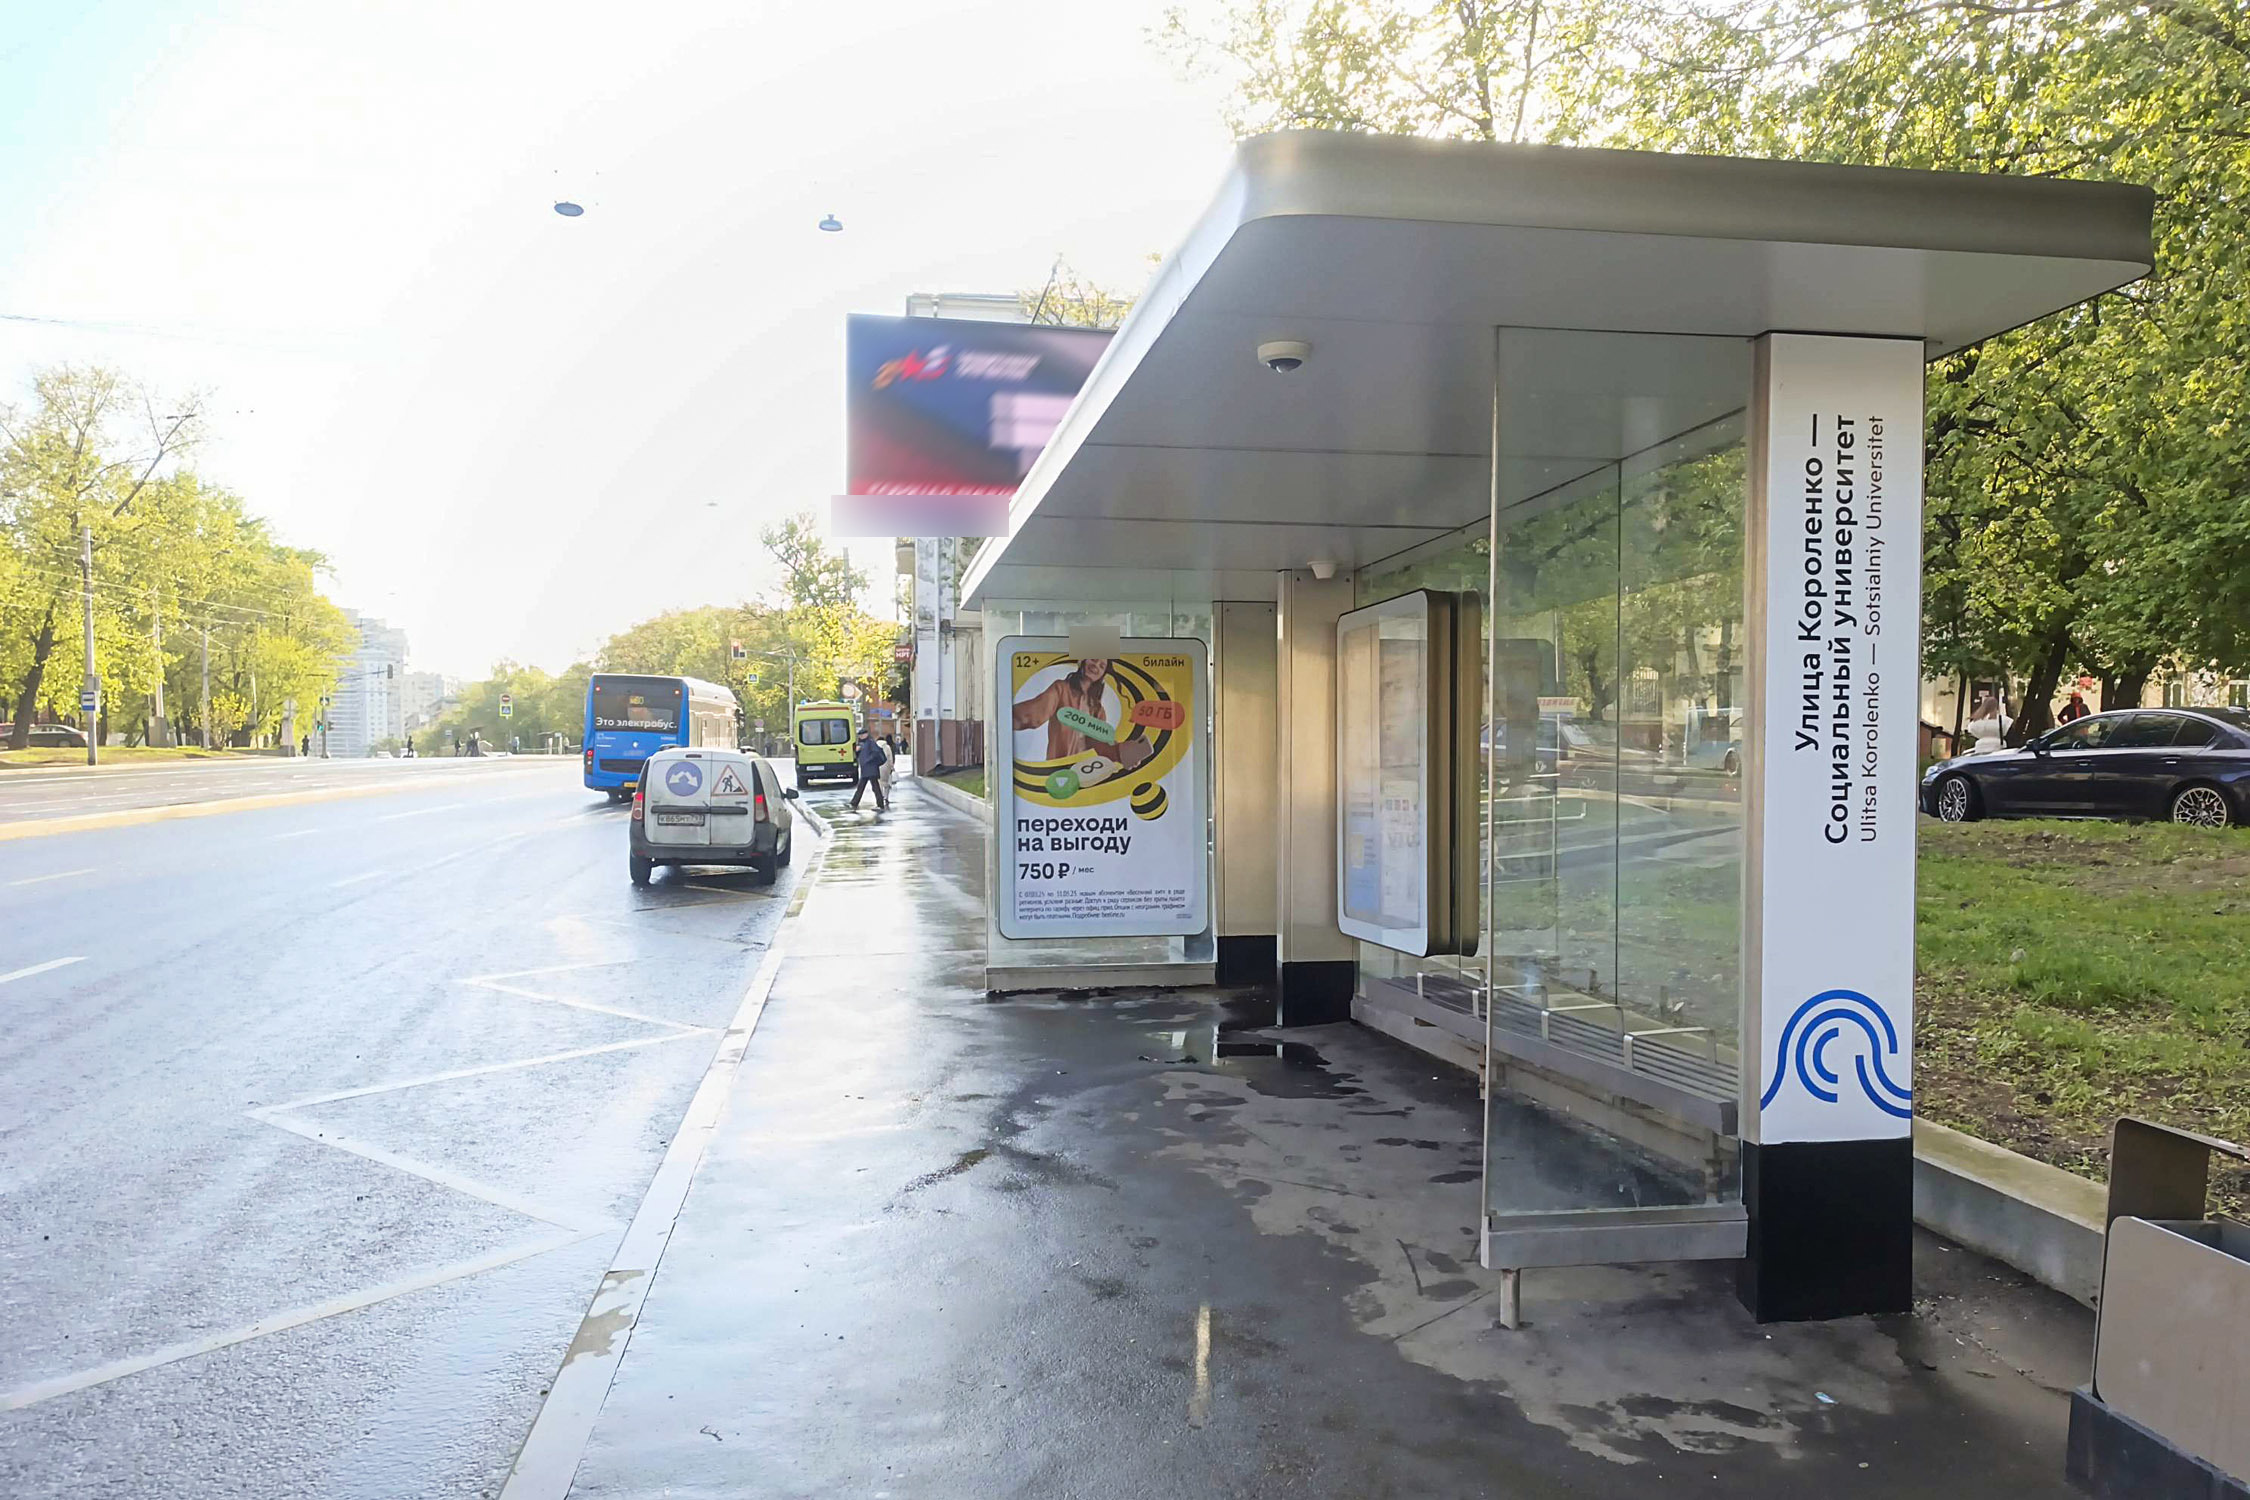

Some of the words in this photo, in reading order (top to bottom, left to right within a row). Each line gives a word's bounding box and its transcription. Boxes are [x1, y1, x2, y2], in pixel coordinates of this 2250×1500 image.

[1866, 415, 1884, 529] Universitet
[1834, 415, 1858, 627] университет
[1798, 457, 1827, 641] Короленко
[1865, 536, 1885, 636] Sotsialniy
[1016, 656, 1039, 668] 12+
[1143, 656, 1185, 667] билайн
[1138, 706, 1153, 718] 50
[1155, 706, 1172, 719] ГБ
[1795, 653, 1824, 751] Улица
[596, 717, 614, 726] Это
[616, 719, 677, 730] электробус.
[1064, 711, 1086, 725] 200
[1087, 721, 1109, 736] мин
[1825, 637, 1852, 844] Социальный
[1862, 672, 1880, 777] Korolenko
[1017, 817, 1128, 836] переходи
[1860, 785, 1877, 842] Ulitsa
[1018, 838, 1044, 852] на
[1051, 836, 1131, 855] выгоду
[1018, 863, 1054, 880] 750
